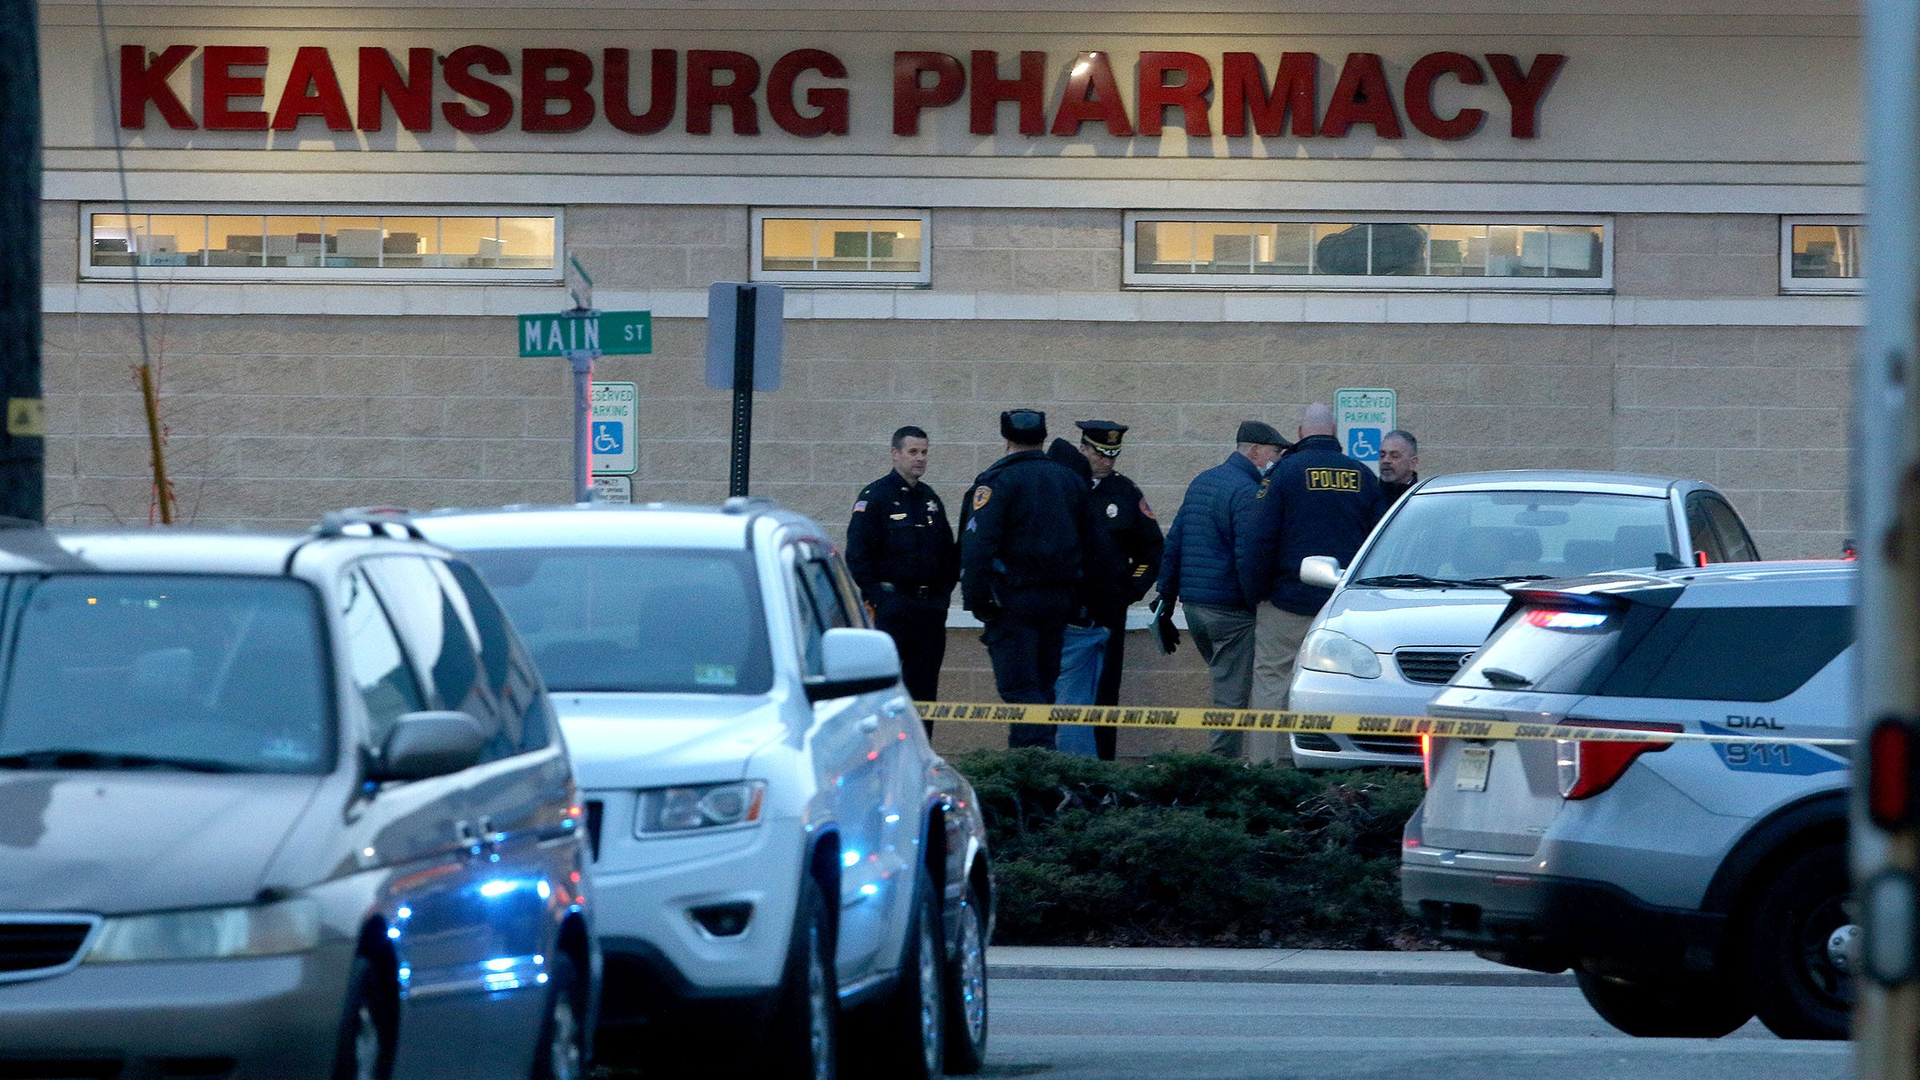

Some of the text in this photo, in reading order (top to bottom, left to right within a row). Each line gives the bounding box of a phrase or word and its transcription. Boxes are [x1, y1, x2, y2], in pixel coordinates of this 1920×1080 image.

[119, 44, 1568, 140] KEANSBURG PHARMACY
[525, 318, 645, 351] MAIN ST
[591, 390, 634, 402] ESERVED
[1340, 396, 1391, 408] RESERVED
[592, 405, 628, 417] ARKING
[1344, 411, 1387, 424] PARKING
[1311, 470, 1357, 489] POLICE
[1048, 708, 1179, 725] POLICE LINE DO NOT CROSS
[1201, 711, 1334, 730] POLICE LINE DO NOT CROSS
[1726, 714, 1785, 730] DIAL
[1356, 717, 1493, 735] POLICE LINE DO NOT CROSS
[1726, 742, 1792, 766] 911
